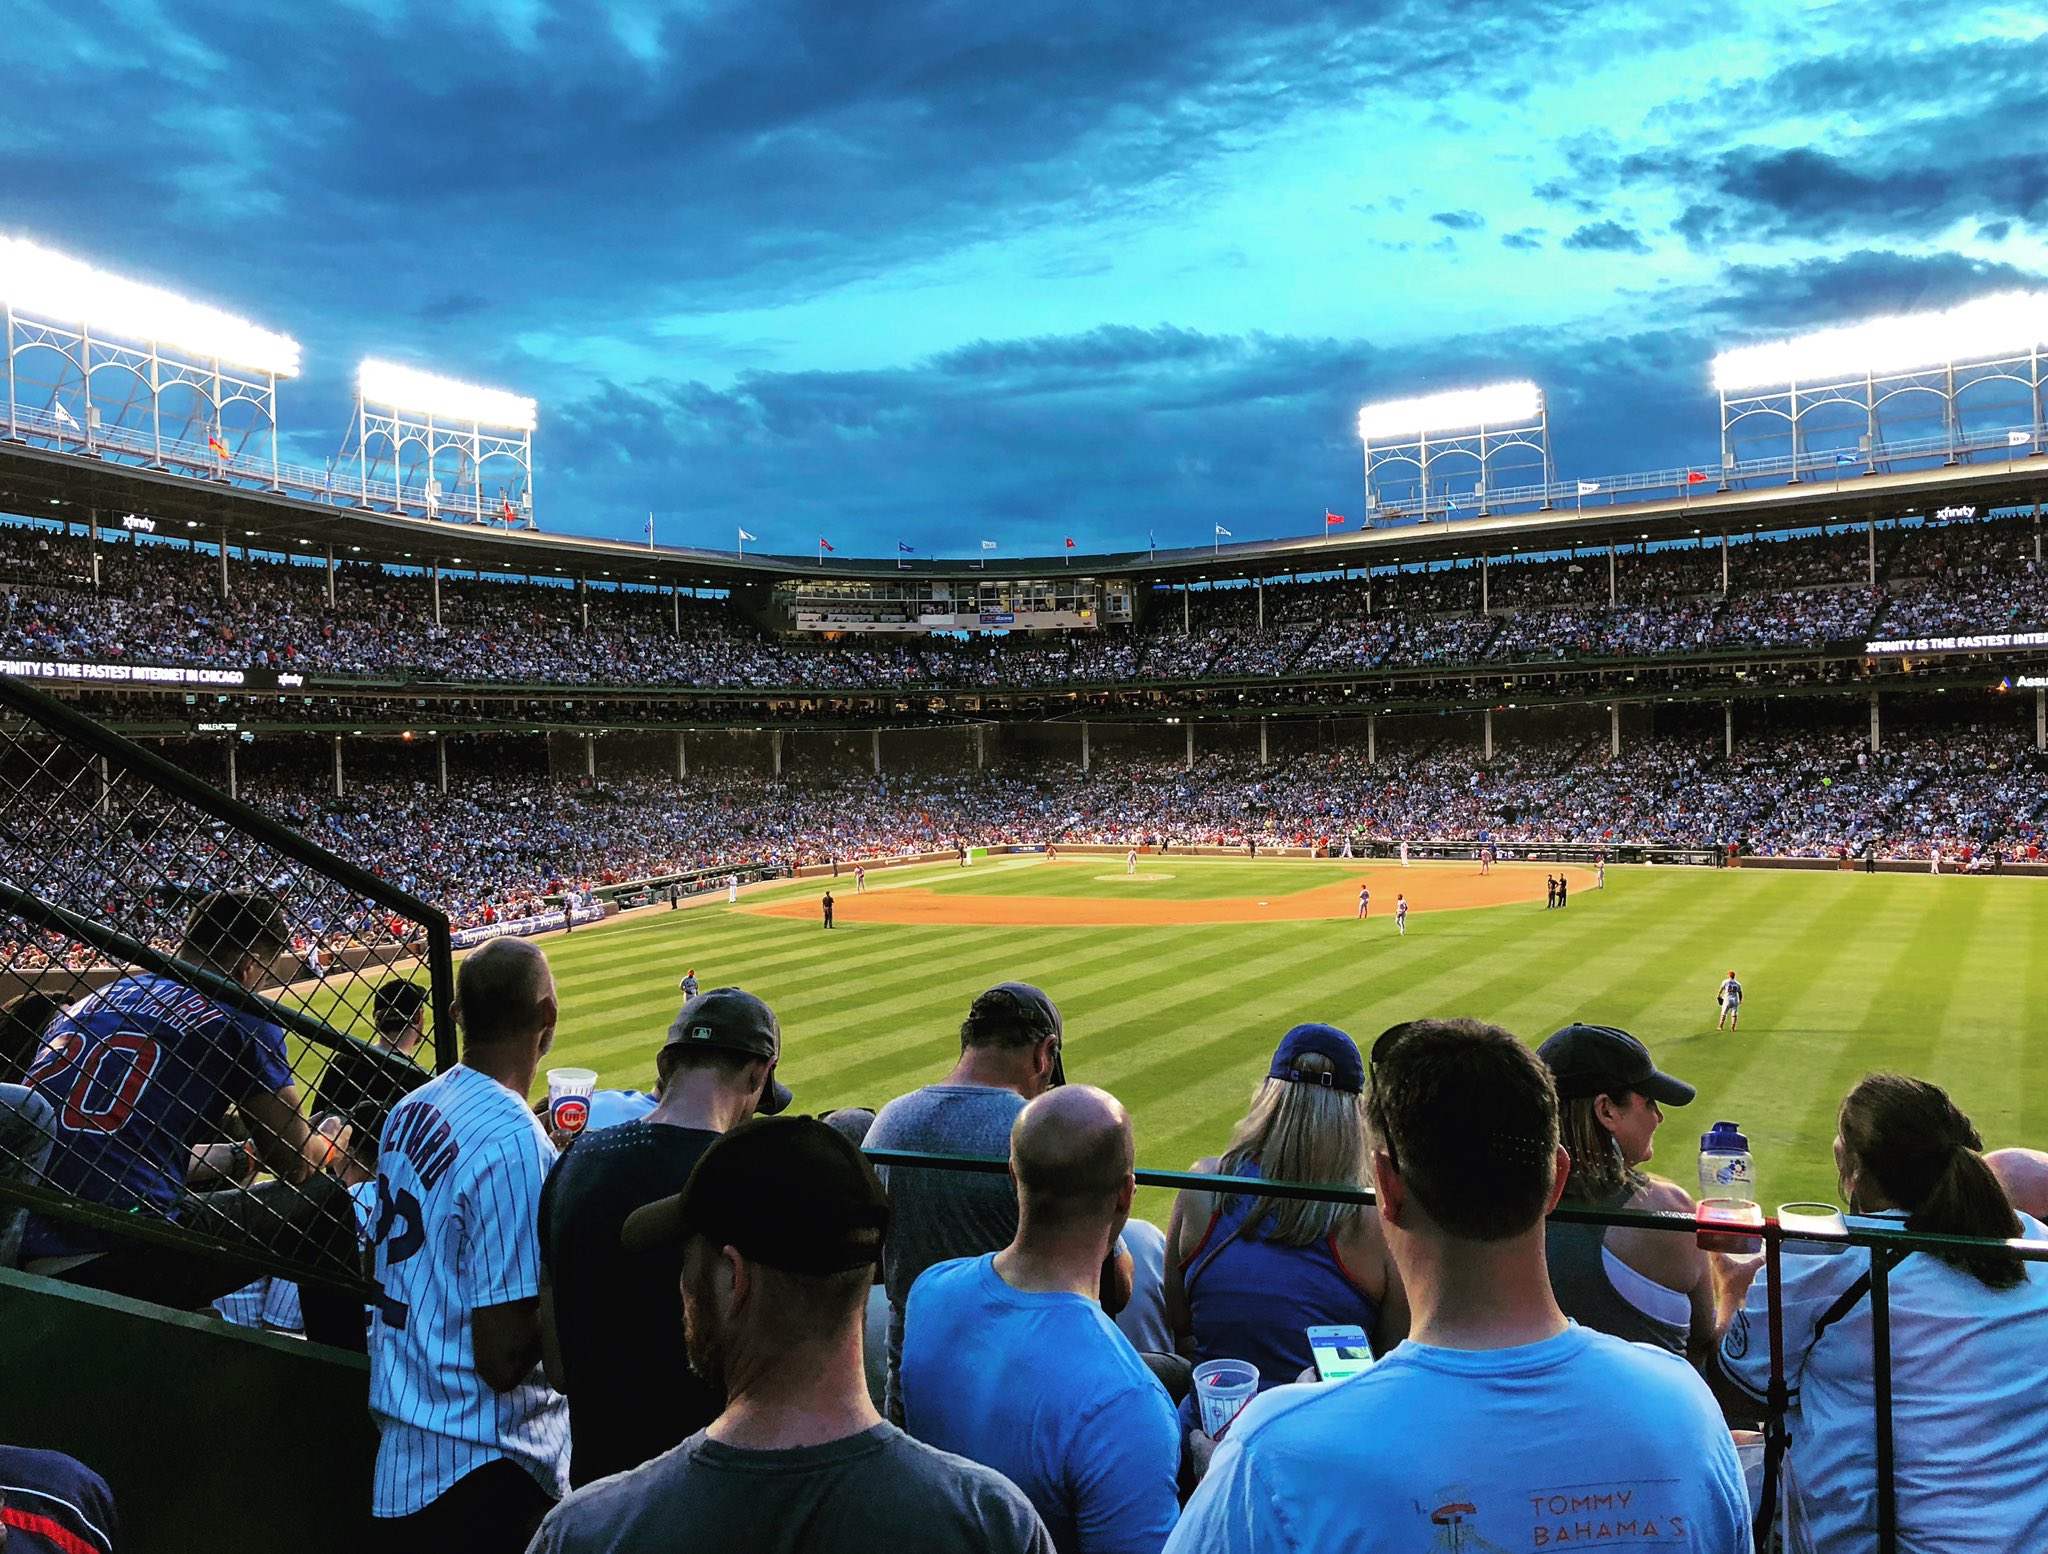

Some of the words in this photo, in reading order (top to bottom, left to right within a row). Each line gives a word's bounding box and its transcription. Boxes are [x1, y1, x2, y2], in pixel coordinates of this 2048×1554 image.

[1937, 505, 1976, 520] xfinity
[123, 514, 156, 532] xfinity
[1866, 639, 1914, 653] XFINITY
[1916, 640, 1928, 651] IS
[1929, 638, 1955, 650] THE
[1957, 634, 2012, 648] FASTEST
[42, 662, 55, 676] IS
[56, 663, 82, 677] THE
[83, 664, 131, 679] FASTEST
[132, 666, 185, 680] INTERNET
[186, 668, 198, 681] IN
[199, 669, 244, 683] CHICAGO
[501, 922, 523, 936] Wrap
[1530, 1490, 1632, 1516] TOMMY
[1534, 1516, 1687, 1547] BAHAMA'S
